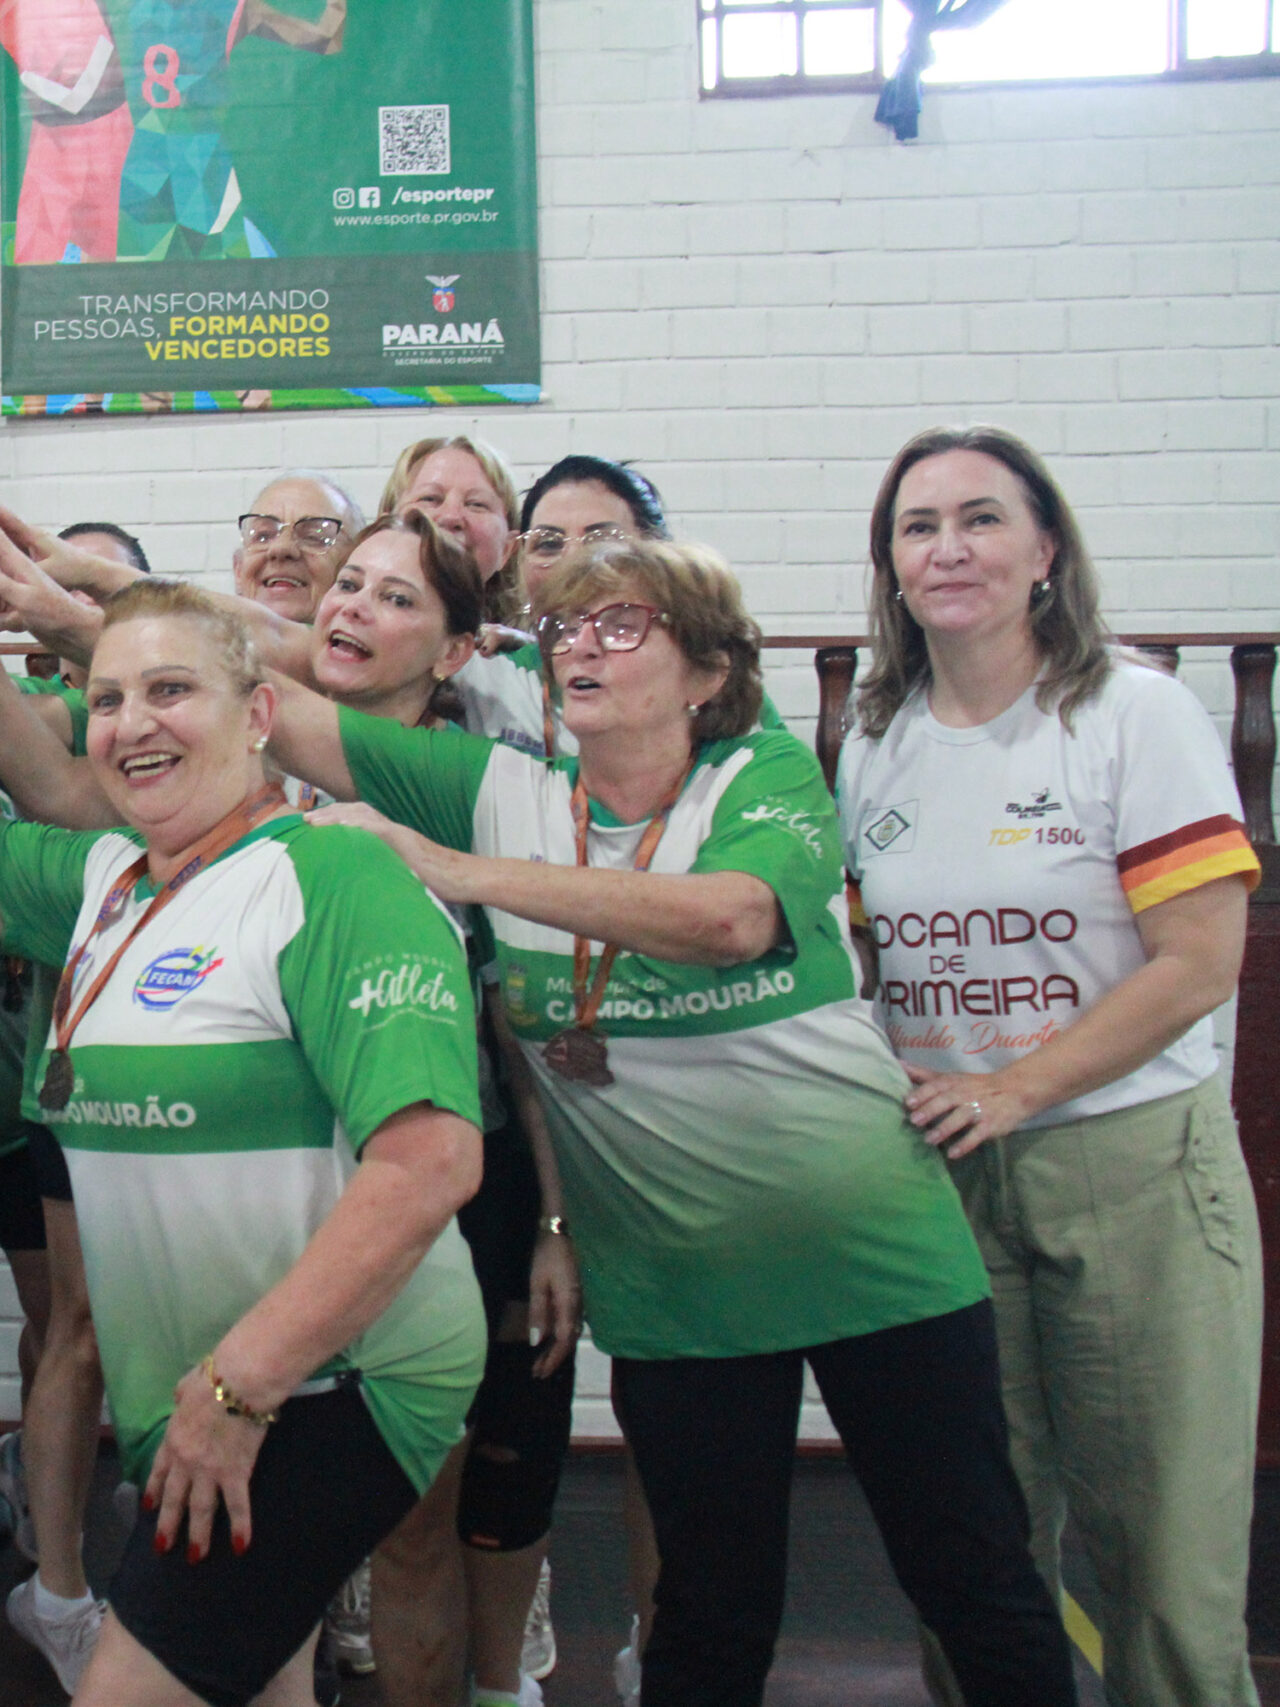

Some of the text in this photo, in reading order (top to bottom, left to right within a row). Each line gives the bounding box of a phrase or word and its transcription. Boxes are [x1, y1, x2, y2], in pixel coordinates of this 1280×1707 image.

[142, 44, 181, 109] 8
[392, 186, 495, 205] /esportepr
[334, 210, 499, 227] www.esporte.pr.gov.br
[79, 289, 329, 316] TRANSFORMANDO
[34, 313, 330, 341] PESSOAS, FORMANDO
[382, 318, 505, 345] PARANÁ
[145, 336, 331, 361] VENCEDORES
[867, 908, 1078, 950] OCANDO
[929, 954, 966, 975] DE
[660, 970, 794, 1021] MOURÃO
[880, 974, 1080, 1017] RIMEIRA
[82, 1095, 197, 1128] MOURÃO
